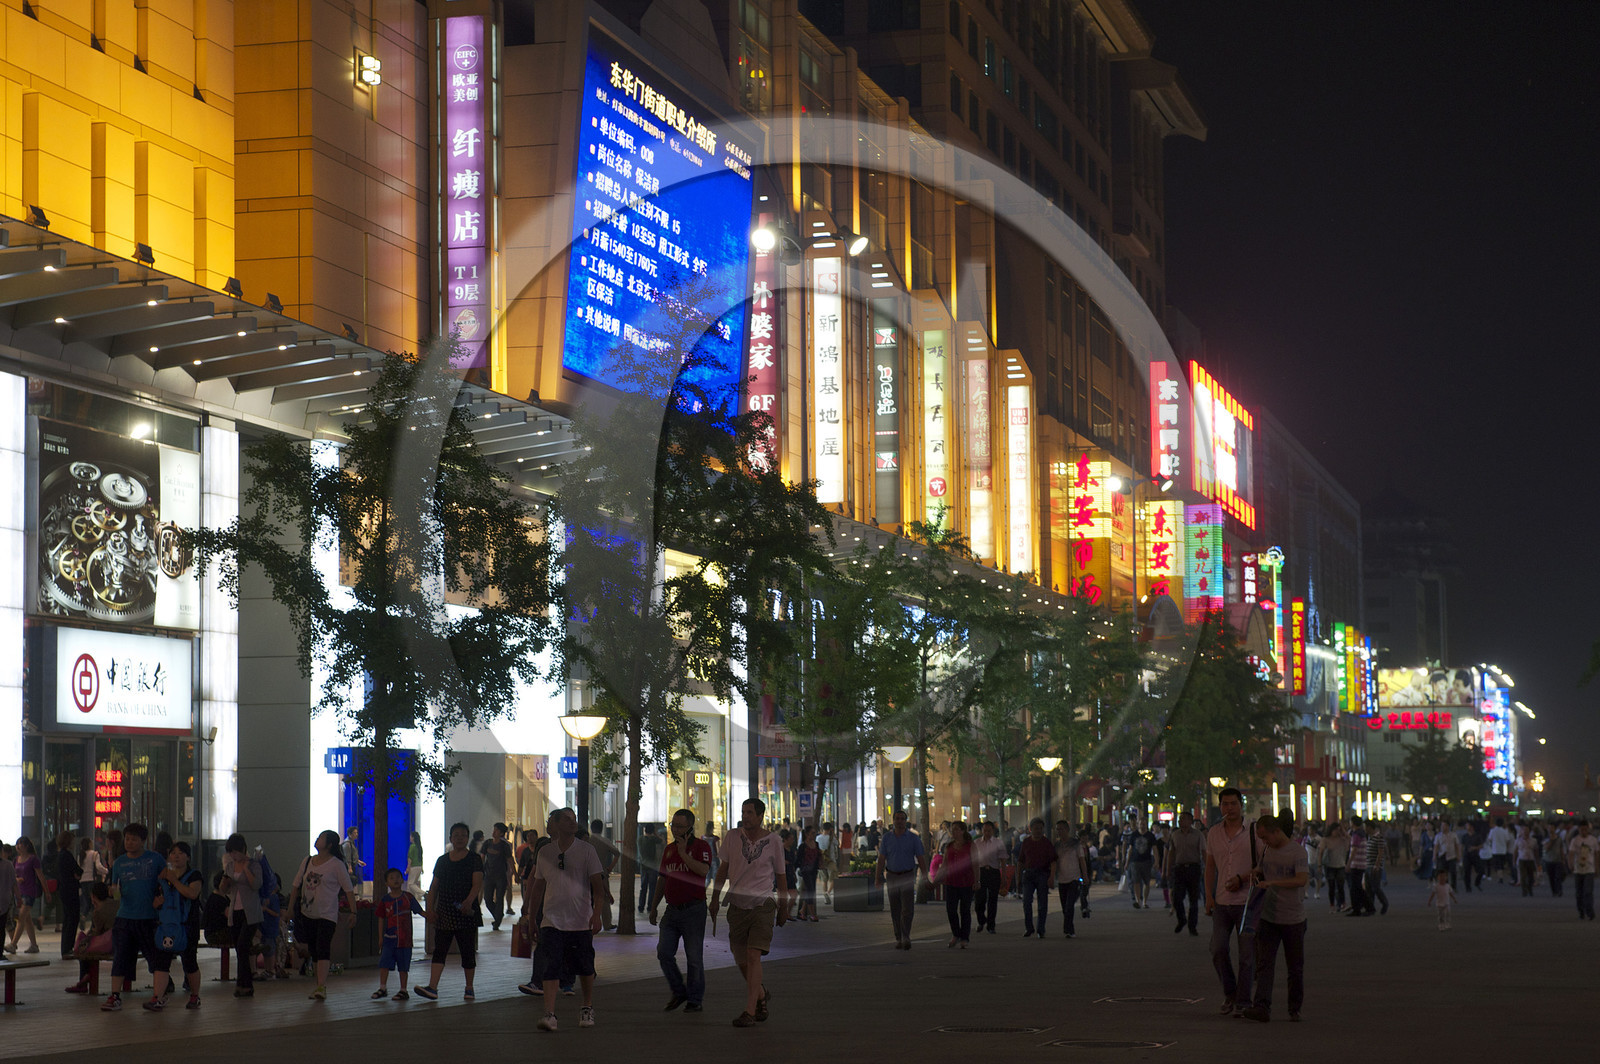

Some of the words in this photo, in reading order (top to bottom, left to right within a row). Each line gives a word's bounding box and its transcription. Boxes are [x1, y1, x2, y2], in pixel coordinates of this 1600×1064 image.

[456, 50, 476, 59] EIFC
[452, 73, 478, 86] 欧亚
[453, 88, 478, 102] 美创
[610, 61, 717, 156] 东华门街道职业介绍所
[597, 143, 632, 179] 岗位名称
[635, 167, 660, 197] 保洁员
[452, 128, 481, 242] 纤瘦店
[595, 171, 669, 230] 招聘总人数性别不限
[672, 219, 681, 235] 15
[593, 199, 628, 233] 招聘年龄
[632, 222, 656, 248] 18至55
[658, 236, 690, 269] 用工形式
[588, 254, 624, 288] 工作地点
[455, 284, 479, 300] 9层
[587, 277, 614, 306] 区保洁
[585, 304, 621, 337] 其他说明
[749, 281, 774, 370] 外婆家
[749, 394, 775, 411] 6F
[107, 702, 128, 713] BANK
[130, 704, 140, 715] OF
[140, 704, 167, 716] CHINA
[331, 754, 348, 768] GAP
[563, 761, 578, 774] GAP
[702, 851, 709, 861] 5
